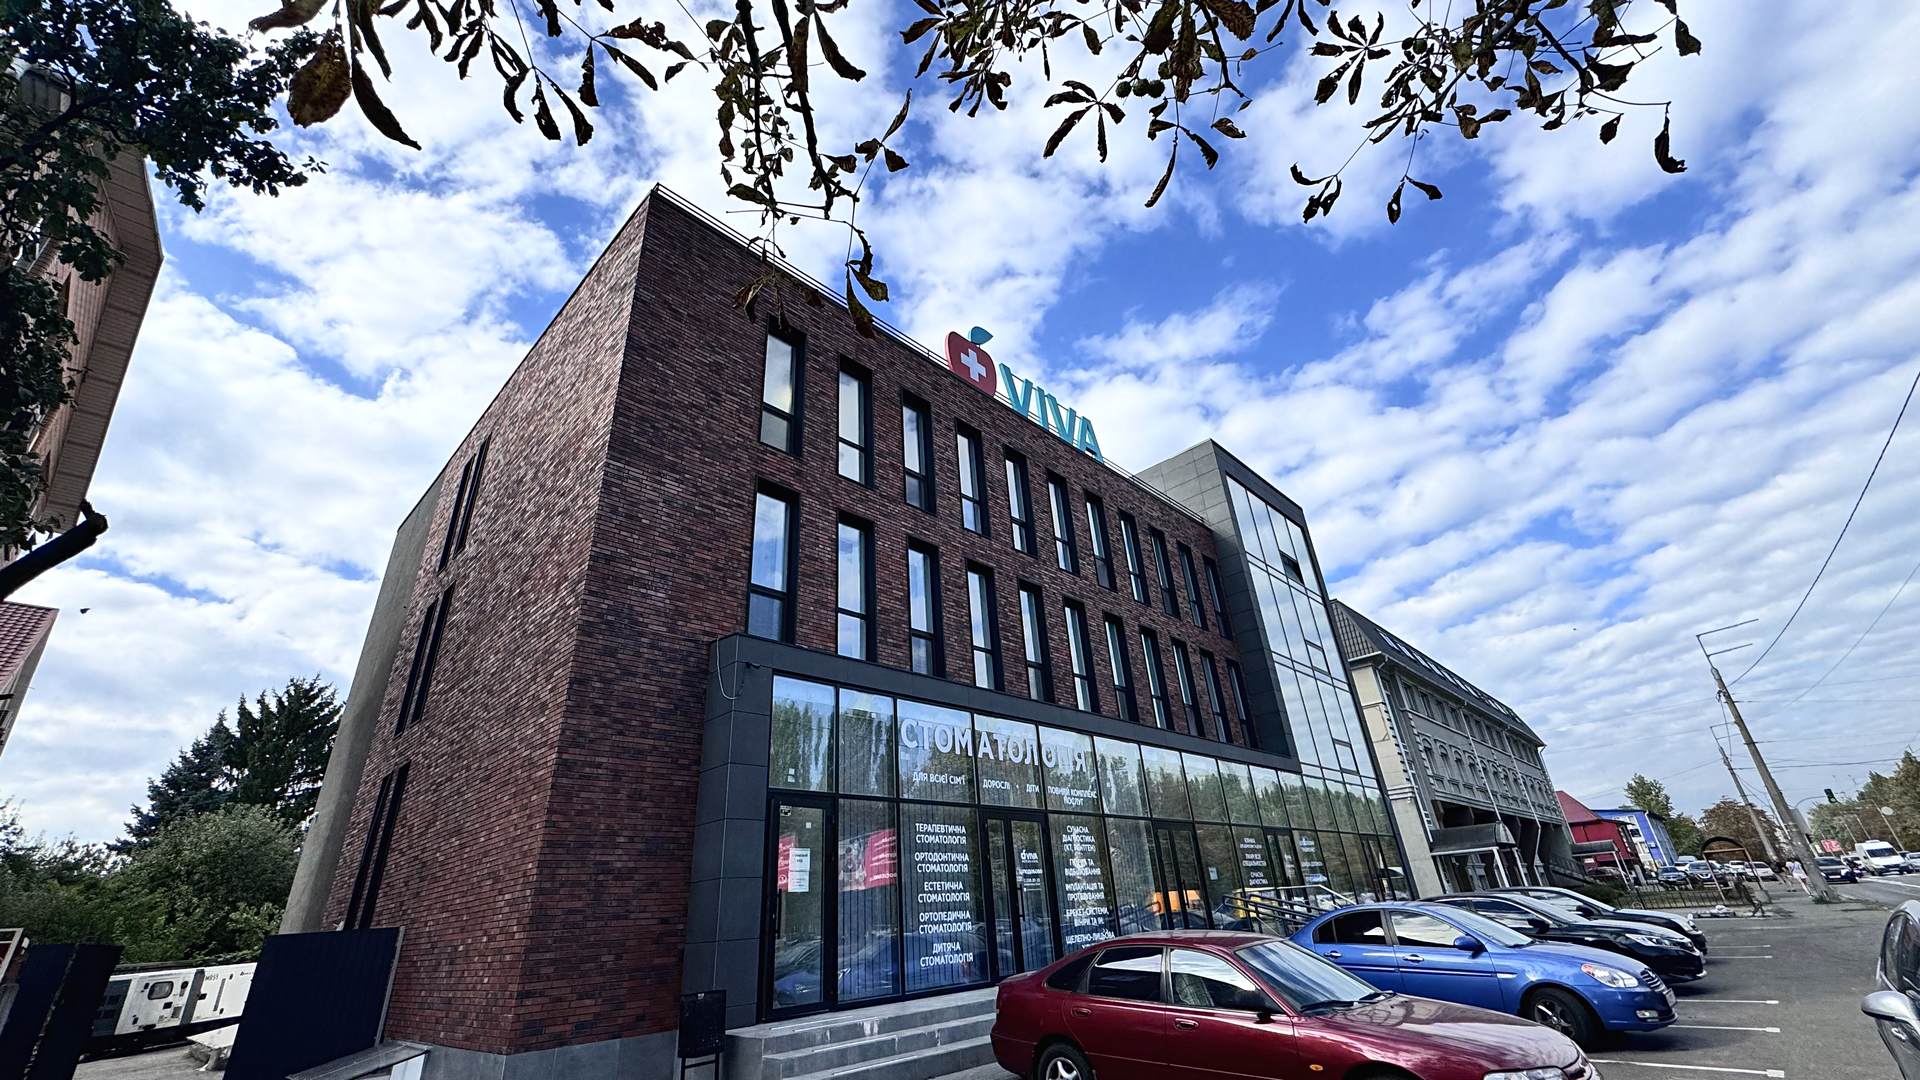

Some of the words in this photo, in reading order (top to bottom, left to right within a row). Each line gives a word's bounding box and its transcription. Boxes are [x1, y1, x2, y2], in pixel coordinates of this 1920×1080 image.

[998, 362, 1104, 464] VIVA
[900, 718, 1087, 772] СТОМАТОЛОЯ
[912, 771, 929, 782] ДЛЯ
[982, 778, 1011, 790] ДОРОСЛІ
[1026, 783, 1040, 793] ДІТИ
[915, 822, 967, 835] ТЕРАПЕВТИЧНА
[915, 834, 967, 845] СТОМАТОЛОГІЯ
[914, 851, 970, 862] ОРТОДОНТИЧНА
[916, 863, 969, 873] СТОМАТОЛОГІЯ
[924, 881, 964, 891] ЕСТЕТИЧНА
[1097, 882, 1105, 890] ТА
[917, 892, 971, 903] СТОМАТОЛОГІЯ
[919, 910, 972, 922] ОРТОПЕДИЧНА
[918, 921, 973, 935] СТОМАТОЛОГІЯ
[932, 941, 961, 955] ДИТЯЧА
[920, 952, 974, 967] СТОМАТОЛОГІЯ
